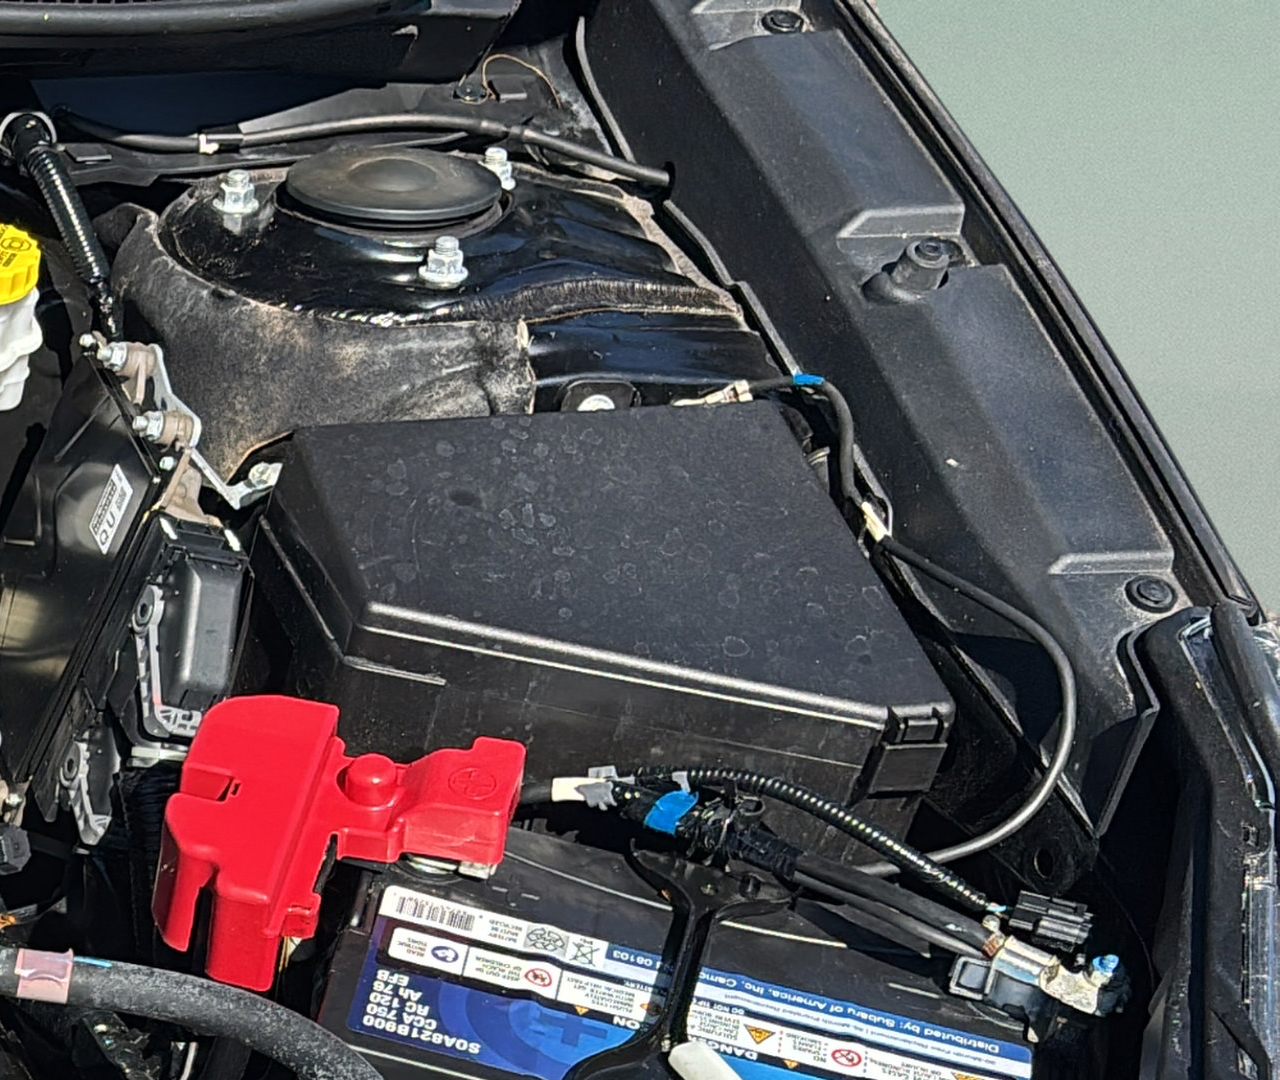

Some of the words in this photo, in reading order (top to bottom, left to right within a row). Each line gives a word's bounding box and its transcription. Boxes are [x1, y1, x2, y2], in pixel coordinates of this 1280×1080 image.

[611, 949, 653, 967] 08103
[375, 967, 410, 987] EFB
[371, 979, 395, 995] 76
[397, 986, 422, 1002] Ah
[367, 990, 401, 1009] 120
[403, 1000, 430, 1016] RC
[828, 1002, 844, 1014] of
[364, 1001, 399, 1020] 750
[400, 1011, 438, 1031] CCA
[897, 1019, 921, 1034] by:
[922, 1026, 1000, 1054] Distributed
[812, 1054, 827, 1063] NO
